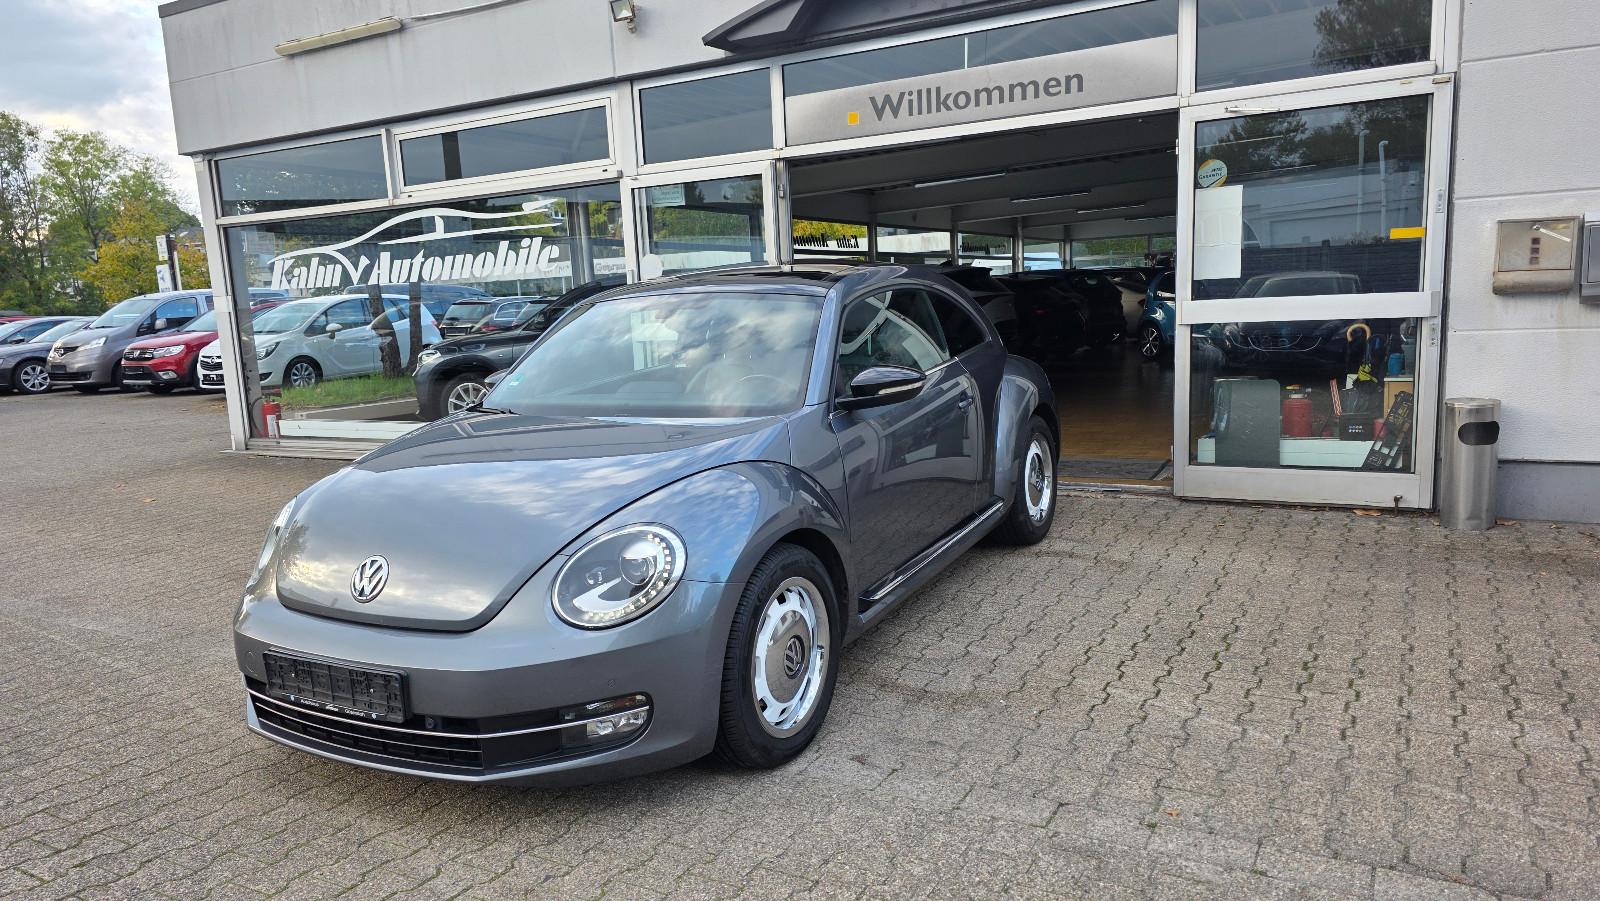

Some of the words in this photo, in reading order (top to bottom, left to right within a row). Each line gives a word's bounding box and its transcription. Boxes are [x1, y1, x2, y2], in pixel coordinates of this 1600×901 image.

[869, 73, 1084, 121] Willkommen
[271, 257, 343, 290] Kahn
[367, 237, 560, 286] Automobile
[351, 555, 389, 603] VW
